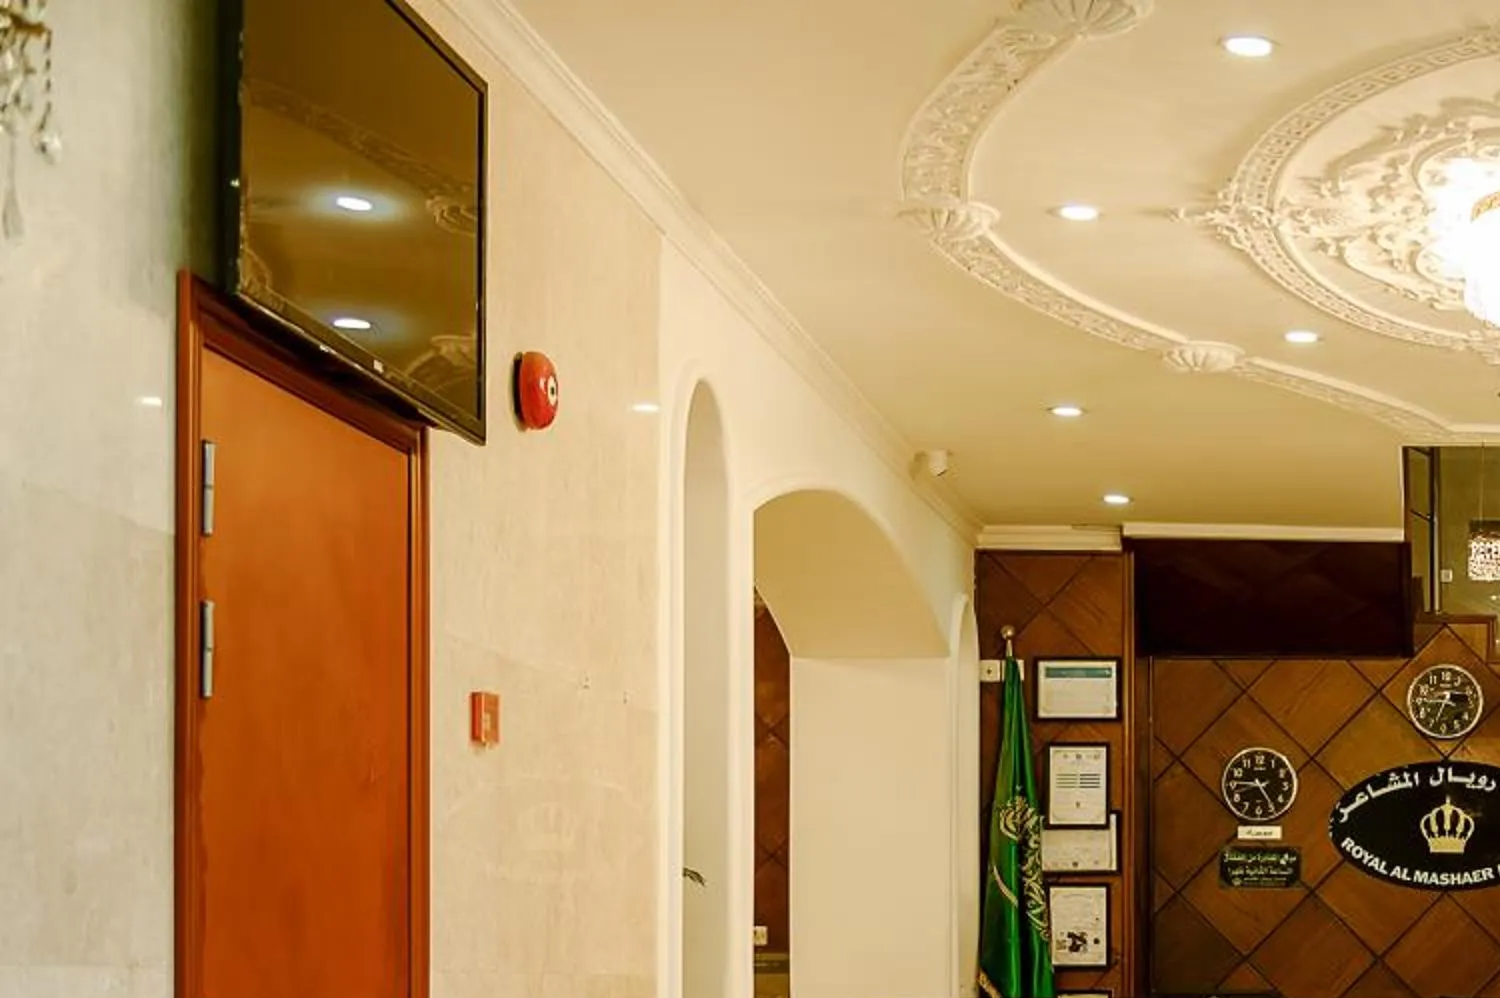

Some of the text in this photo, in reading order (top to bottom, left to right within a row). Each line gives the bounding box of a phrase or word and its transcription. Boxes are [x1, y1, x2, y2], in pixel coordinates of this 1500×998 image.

[1334, 772, 1420, 823] المشاعر
[1428, 766, 1498, 793] رويال
[1341, 837, 1388, 875] ROYAL
[1389, 867, 1412, 882] AL
[1412, 869, 1496, 886] MASHAER
